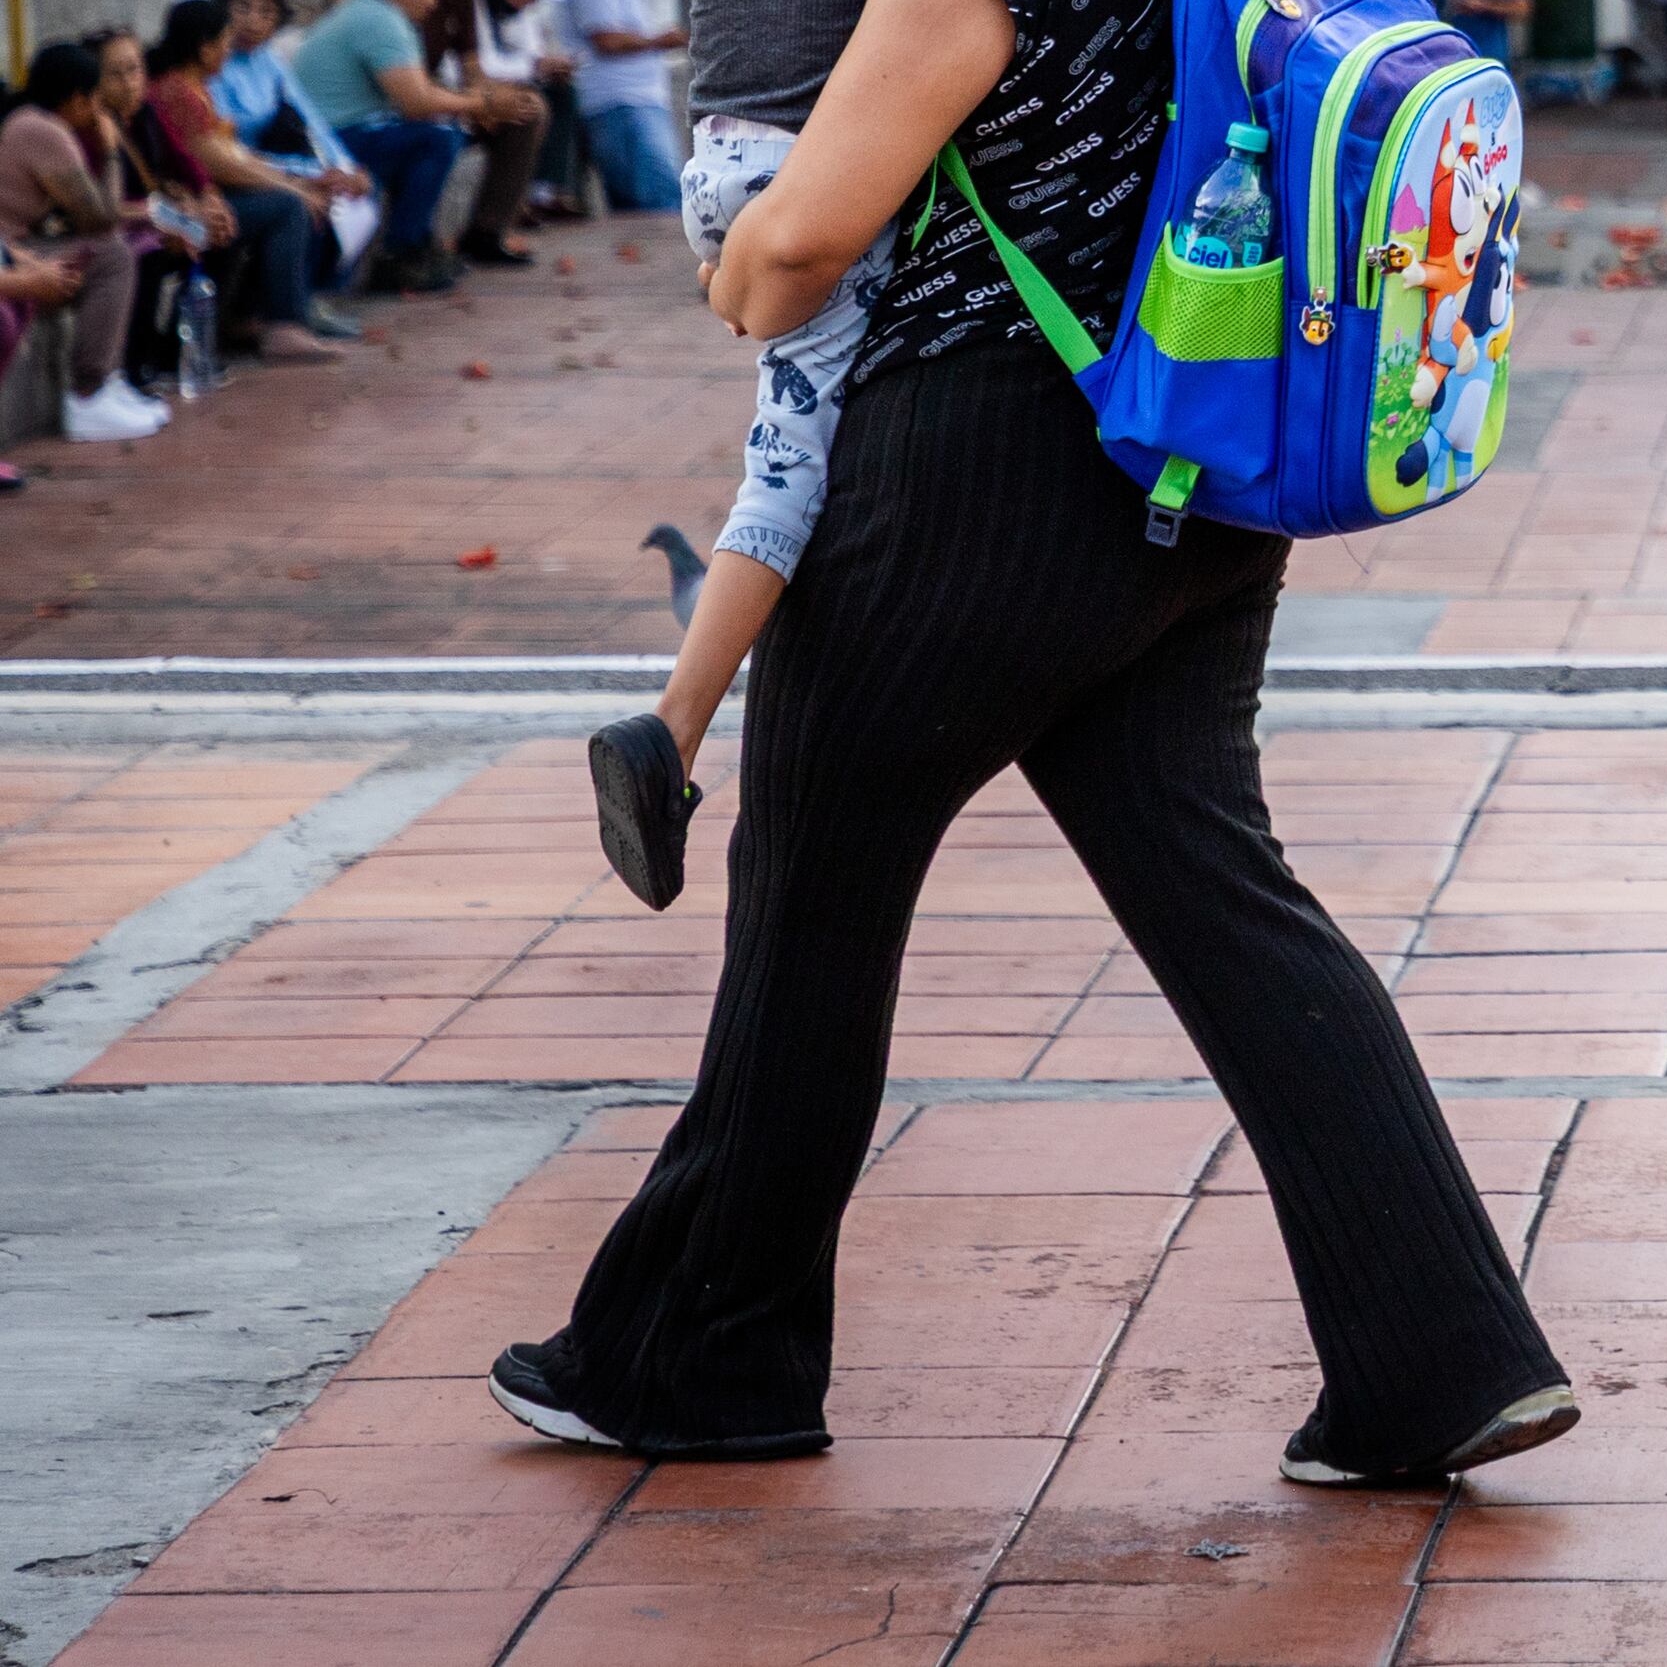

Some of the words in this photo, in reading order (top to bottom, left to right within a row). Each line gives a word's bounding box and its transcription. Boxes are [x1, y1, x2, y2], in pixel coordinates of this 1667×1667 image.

[1068, 16, 1122, 75] GUESS
[975, 96, 1044, 137] GUESS
[1055, 71, 1115, 126] GUESS
[969, 139, 1024, 167] UESS
[1035, 132, 1103, 171] GUESS
[1008, 172, 1080, 210] GUESS
[1087, 172, 1142, 218] GUESS
[1188, 245, 1228, 268] ciel
[965, 280, 1013, 304] GUE
